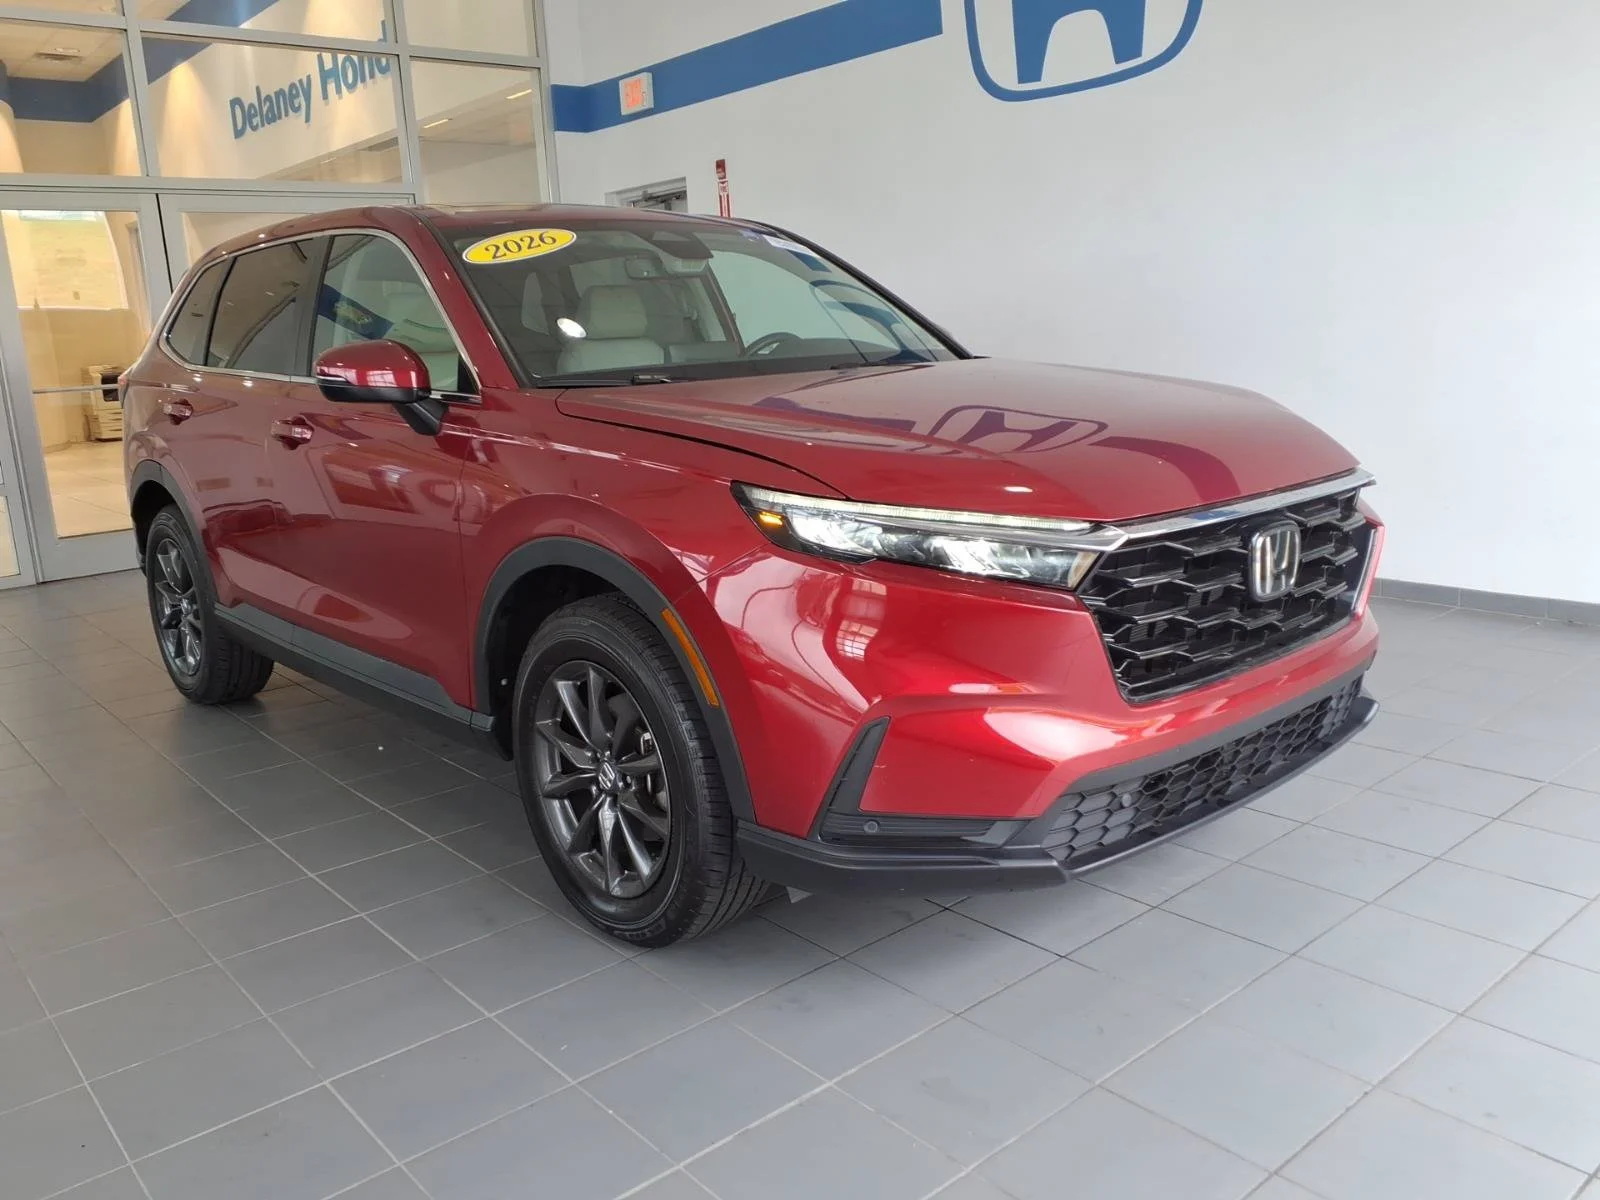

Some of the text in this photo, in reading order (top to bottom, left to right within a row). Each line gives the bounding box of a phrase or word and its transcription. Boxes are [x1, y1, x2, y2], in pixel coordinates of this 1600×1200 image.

[229, 19, 392, 140] Delaney Hond
[484, 231, 558, 260] 2026
